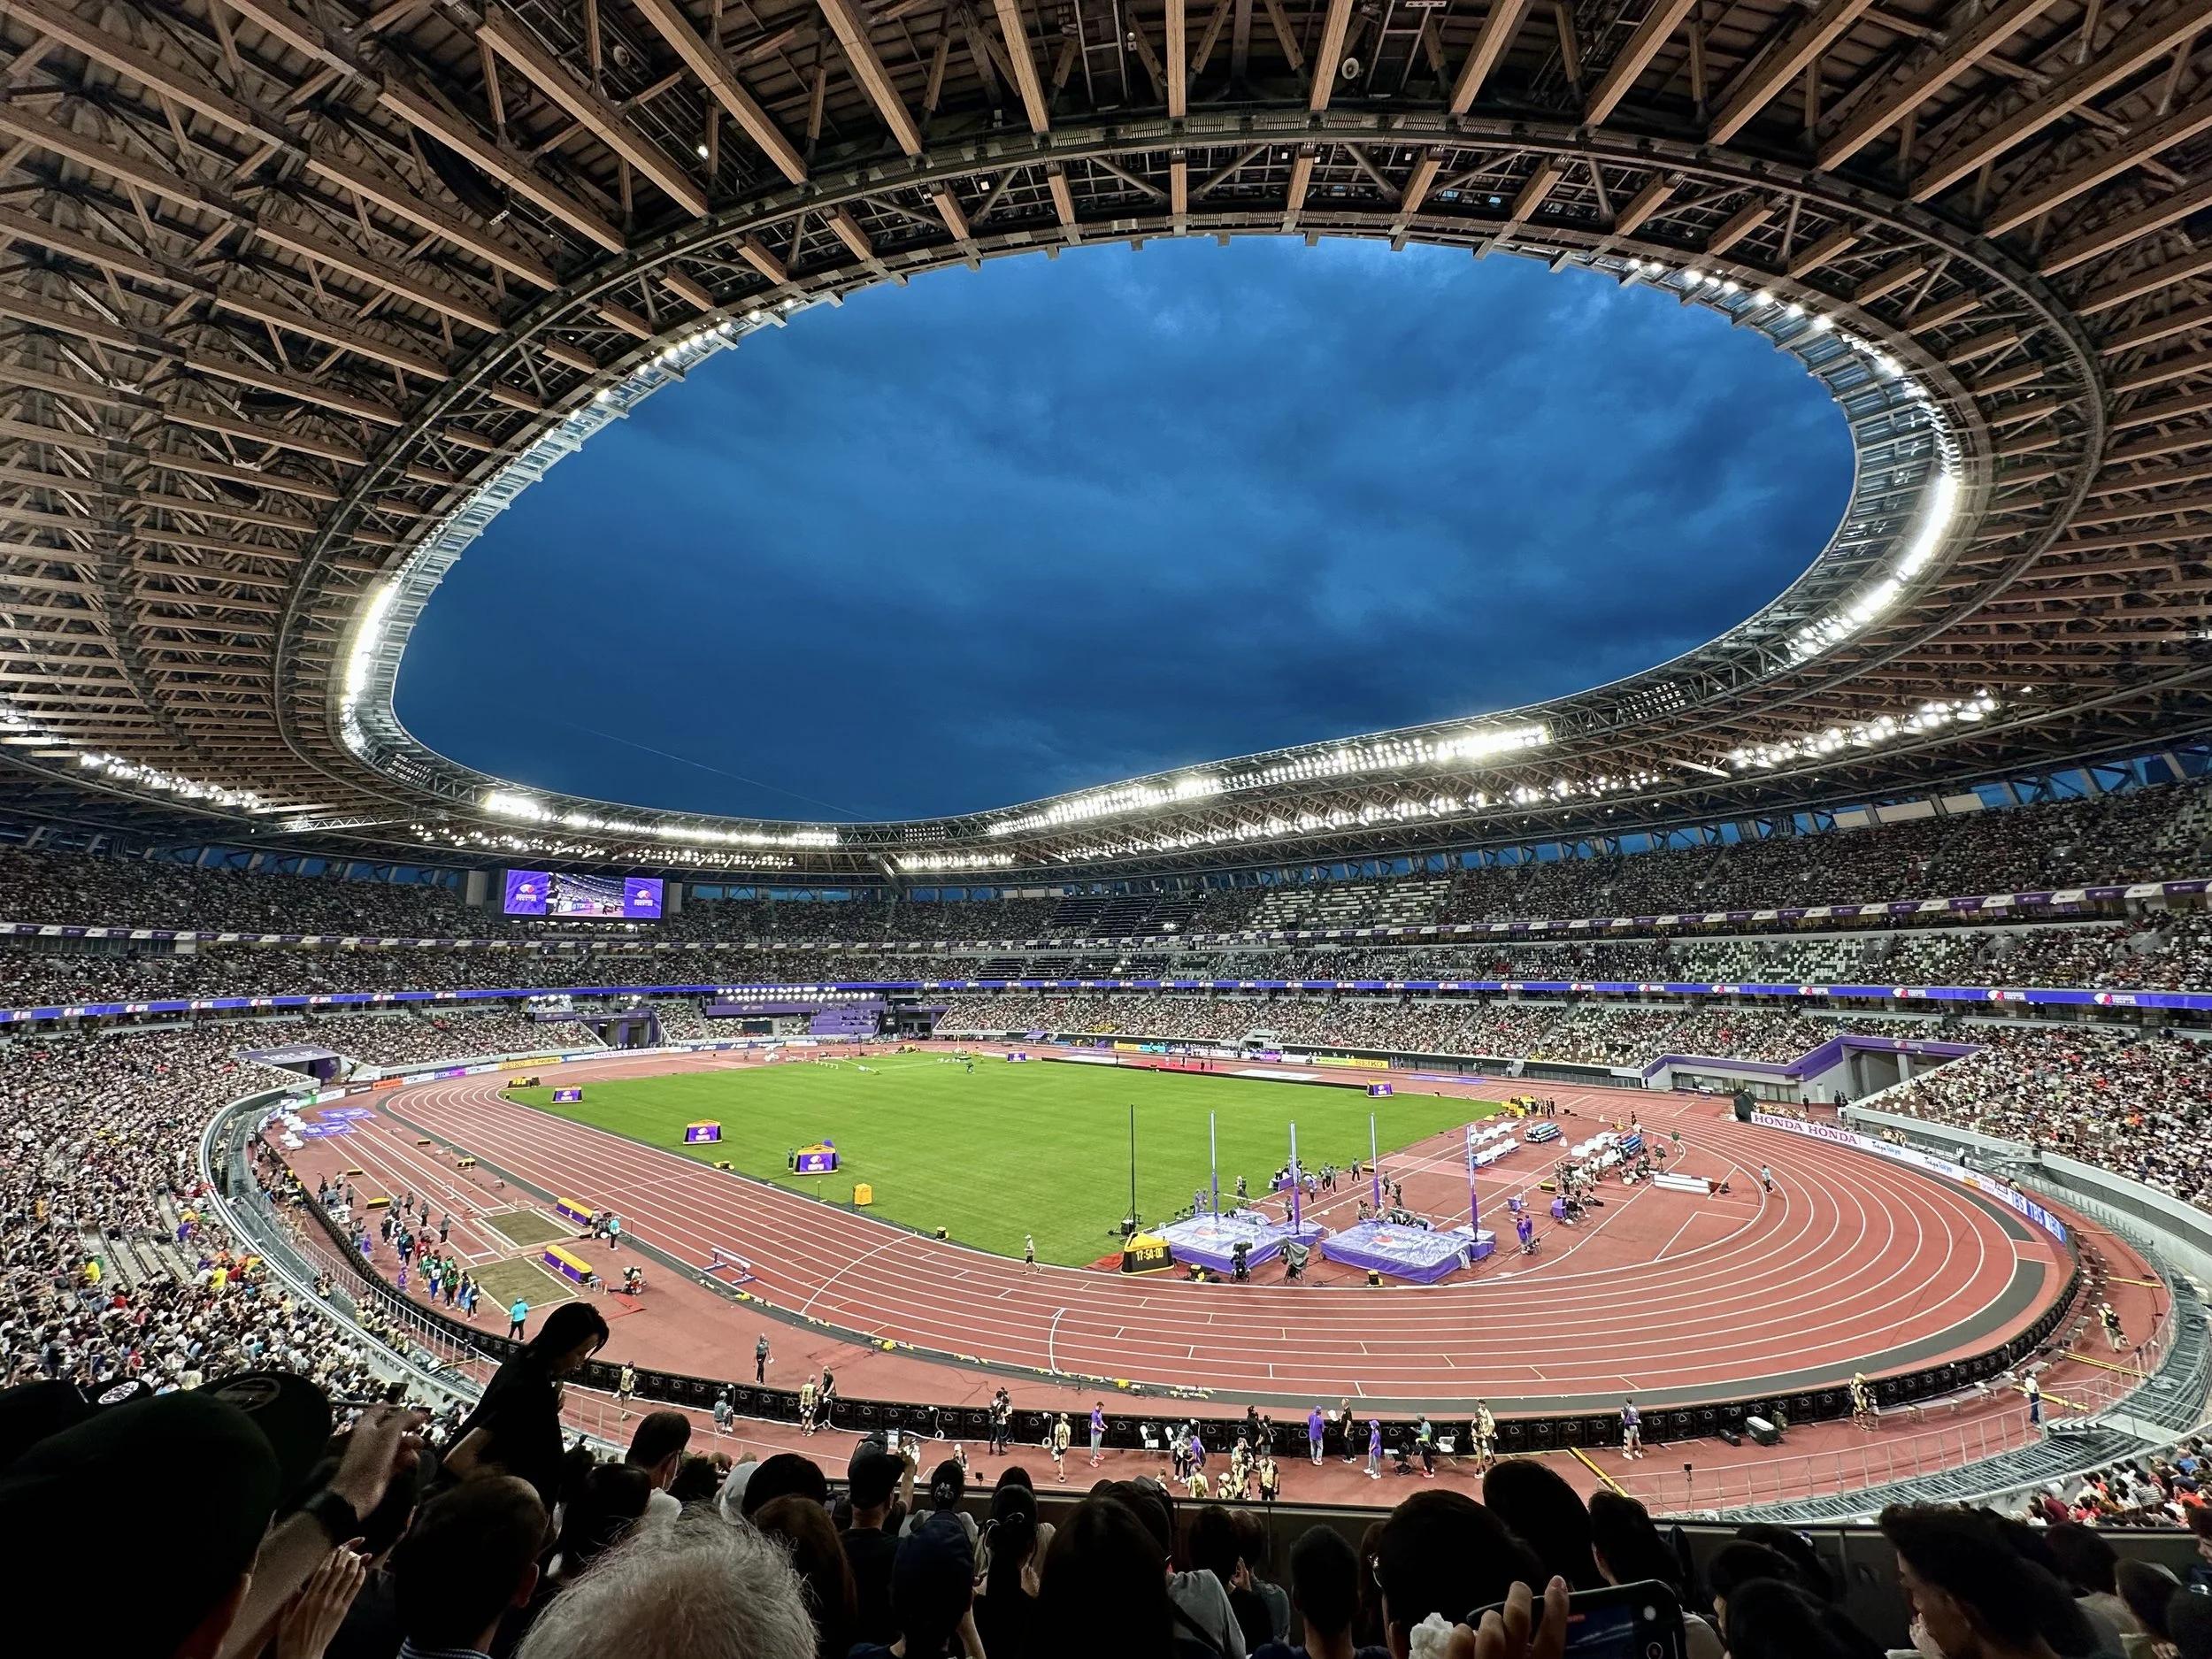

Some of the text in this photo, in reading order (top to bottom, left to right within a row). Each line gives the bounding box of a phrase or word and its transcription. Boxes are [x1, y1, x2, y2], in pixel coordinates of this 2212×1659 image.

[502, 1061, 526, 1070] SEIKO
[1755, 1115, 1858, 1145] HONDA HONDA
[2010, 1190, 2024, 1211] TBS
[2030, 1202, 2044, 1225] TBS
[1135, 1247, 1164, 1262] 17:54:00
